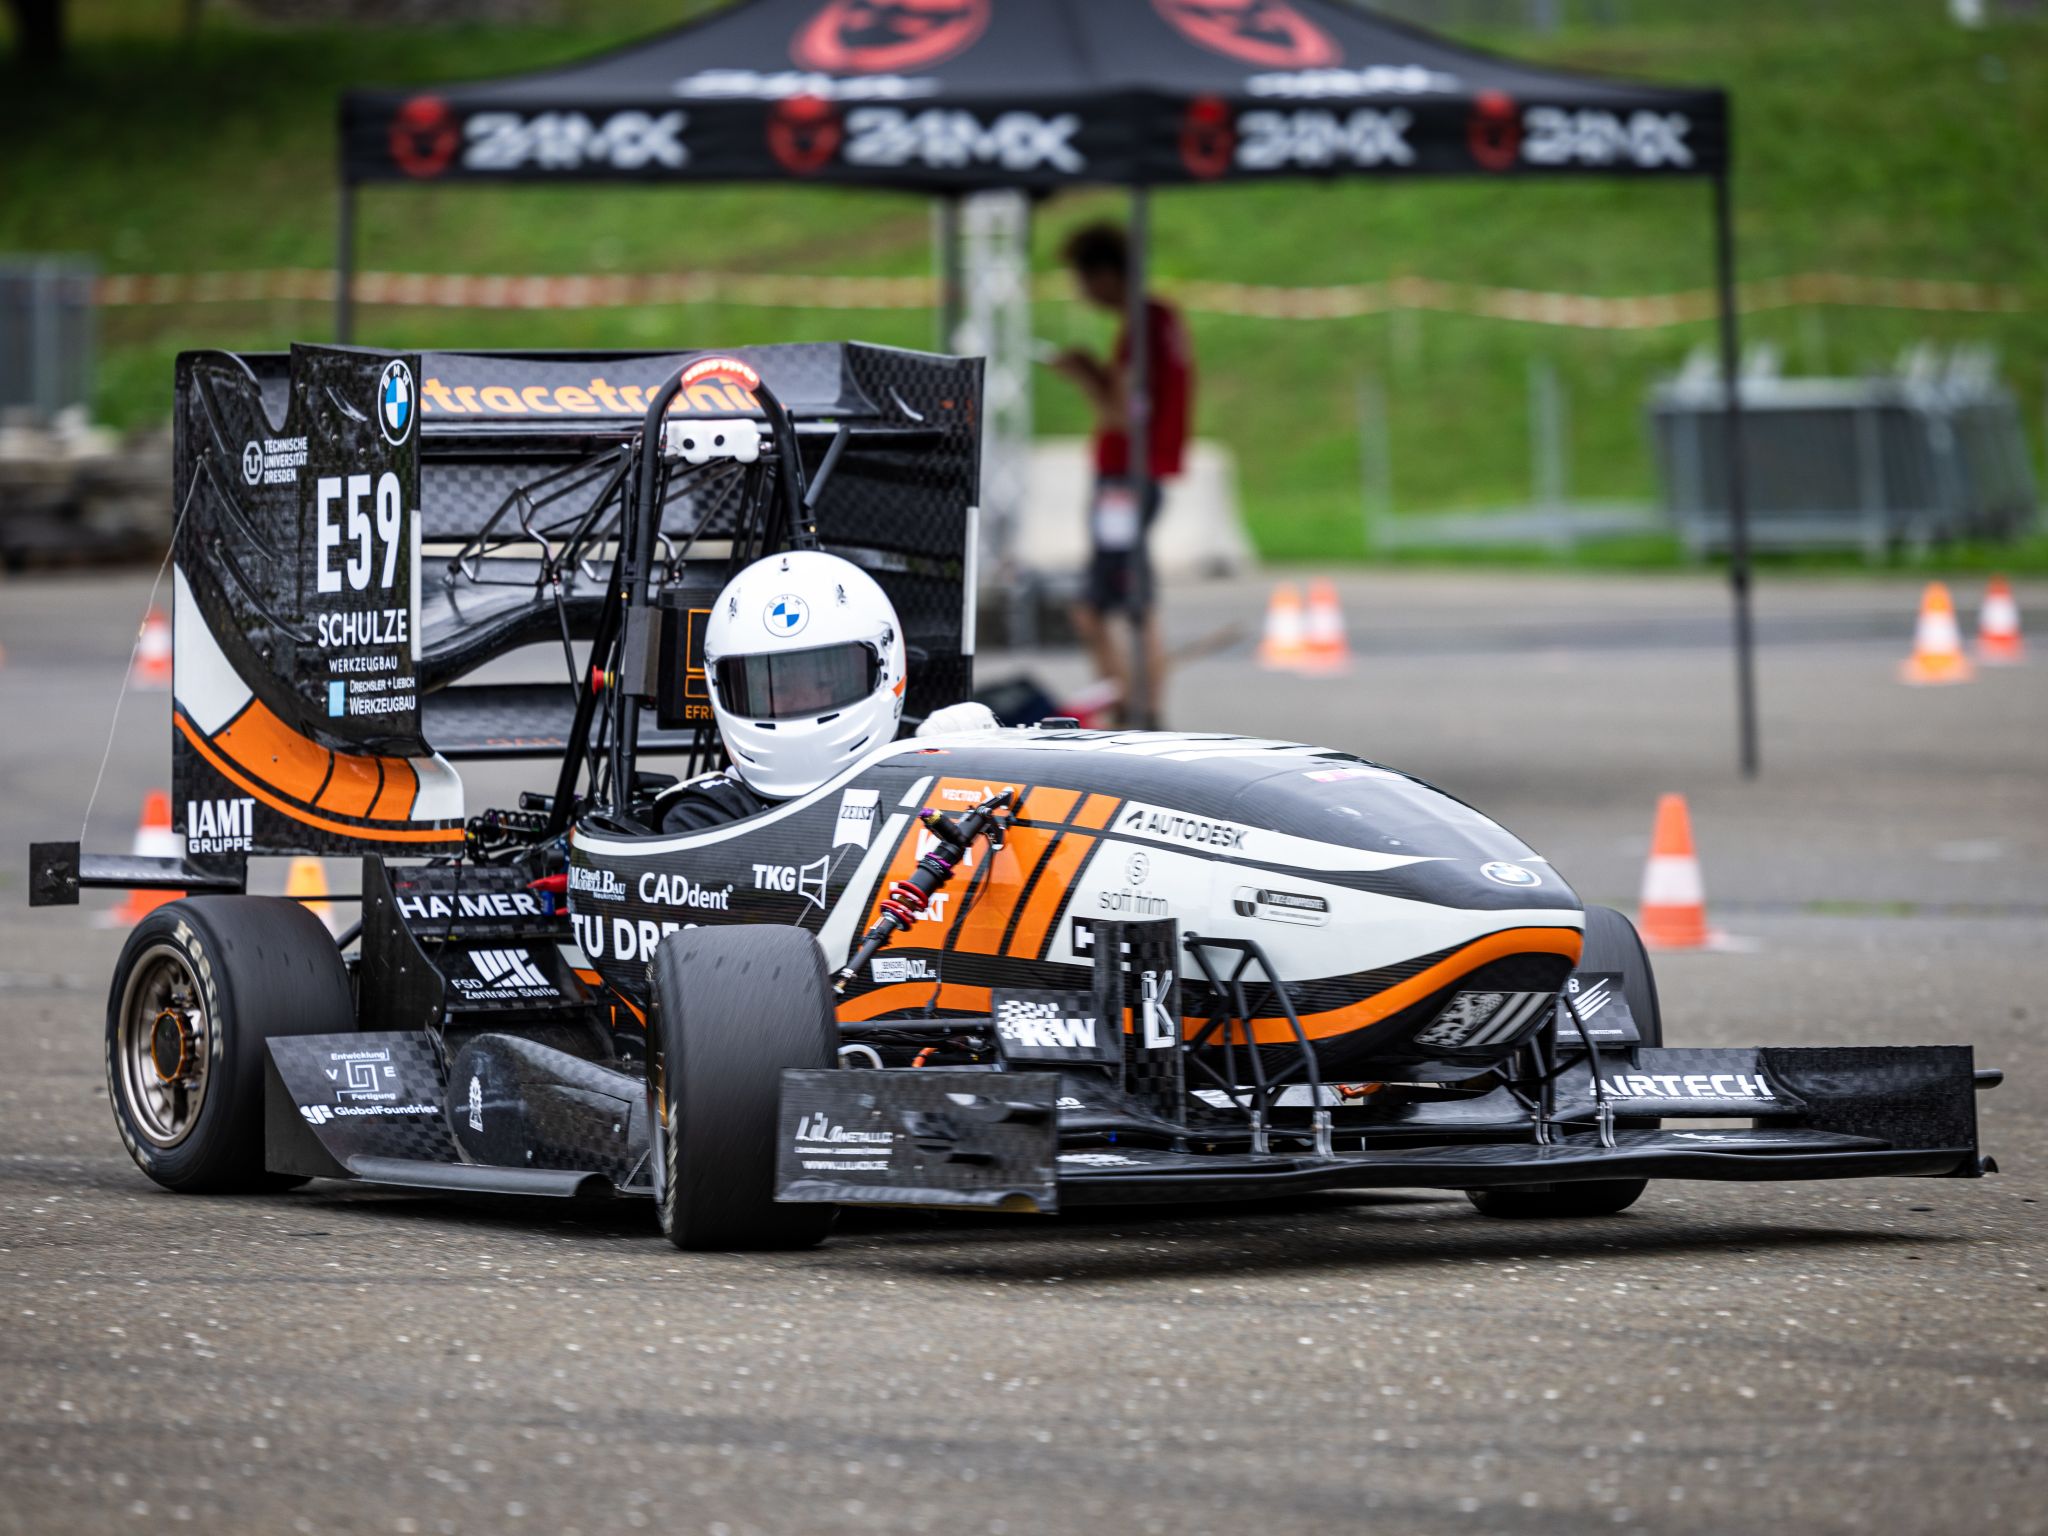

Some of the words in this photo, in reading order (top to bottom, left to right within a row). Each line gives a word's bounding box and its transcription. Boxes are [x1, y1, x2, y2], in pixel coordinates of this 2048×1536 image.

[264, 436, 308, 454] TECHNISCHE
[264, 451, 308, 469] UNIVERSITÄT
[264, 468, 297, 485] DRESDEN
[317, 471, 401, 593] E59
[318, 608, 408, 648] SCHULZE
[329, 655, 398, 674] WERKZEUGBAU
[350, 680, 386, 694] DRECHSLER
[393, 676, 416, 690] LIEBICH
[350, 695, 417, 716] WERKZEUGBAU
[187, 798, 256, 838] IAMT
[1146, 813, 1250, 851] AUTODESK
[189, 837, 253, 854] GRUPPE
[751, 864, 796, 892] TKG
[570, 913, 604, 958] TU
[613, 917, 700, 963] DR
[451, 979, 485, 990] FSD
[461, 987, 517, 1000] Zentrale
[518, 985, 560, 998] Stelle
[1018, 1017, 1097, 1048] KW
[331, 1051, 386, 1062] Entwicklung
[383, 1065, 397, 1078] E
[1589, 1073, 1774, 1098] AIRTECH
[351, 1091, 396, 1101] Fertigung
[334, 1103, 439, 1117] GlobalFoundries
